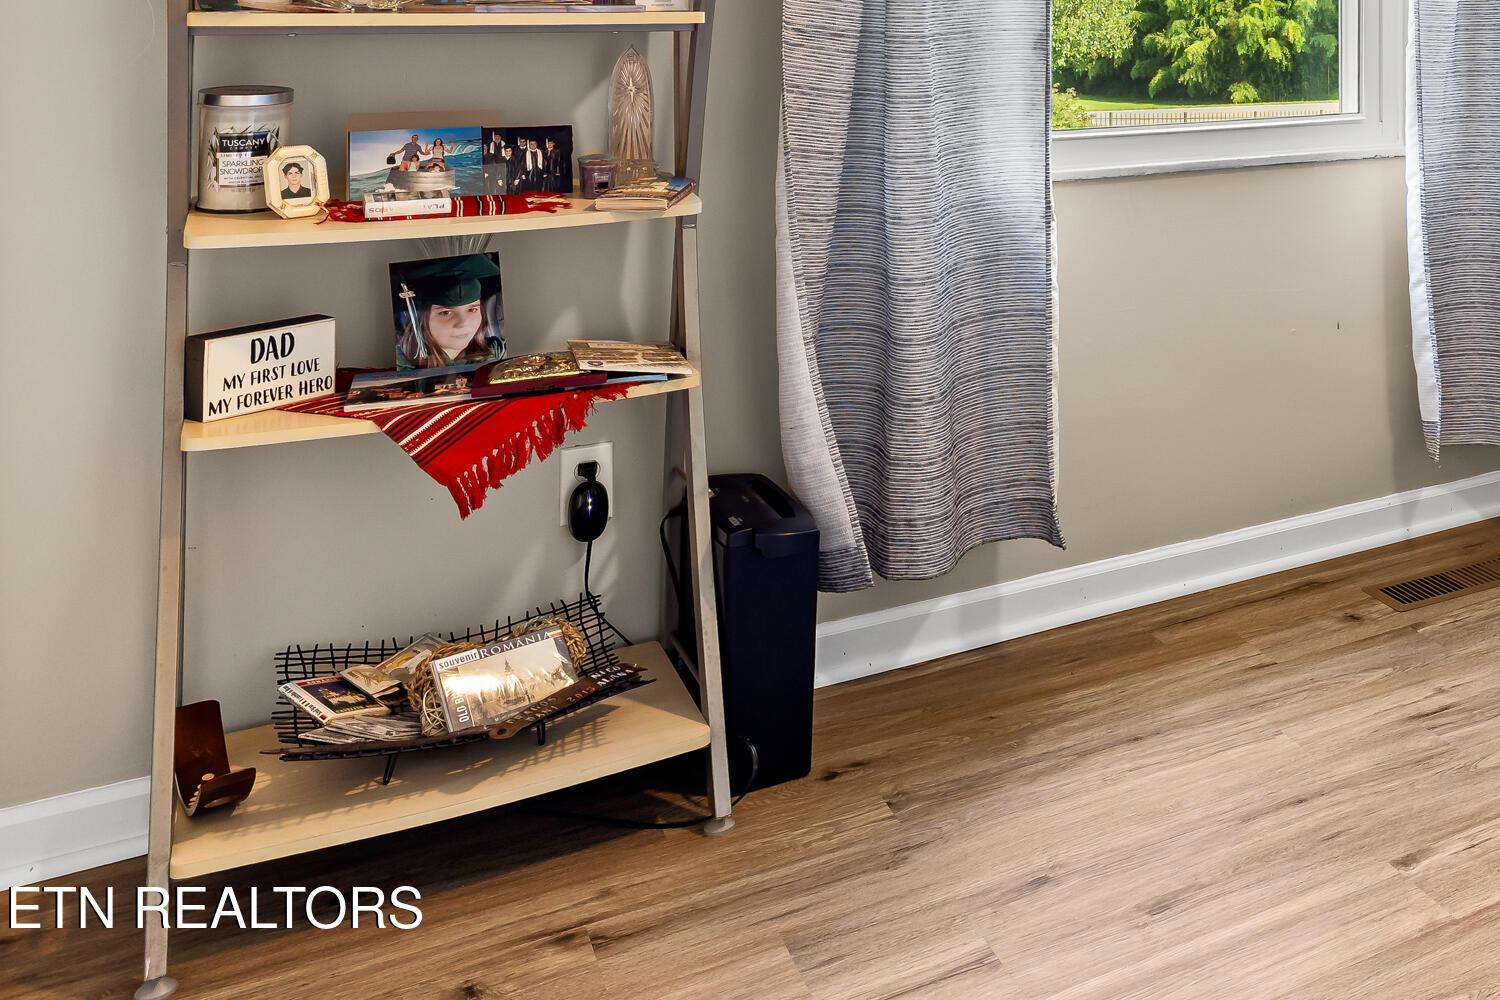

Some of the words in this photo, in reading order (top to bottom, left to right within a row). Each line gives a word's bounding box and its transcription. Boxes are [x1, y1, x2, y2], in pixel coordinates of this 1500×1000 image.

[222, 138, 265, 147] TUSCANY
[222, 158, 264, 167] SPARKLING
[250, 332, 295, 364] DAD
[222, 373, 246, 391] MY
[250, 364, 287, 386] FIRST
[290, 357, 321, 377] LOVE
[208, 397, 232, 416] MY
[237, 384, 294, 410] FOREVER
[298, 375, 333, 396] HERO
[438, 651, 478, 670] souvenir
[480, 631, 552, 658] ROMÂNIA
[597, 669, 634, 686] ALANA
[456, 705, 470, 723] OLD
